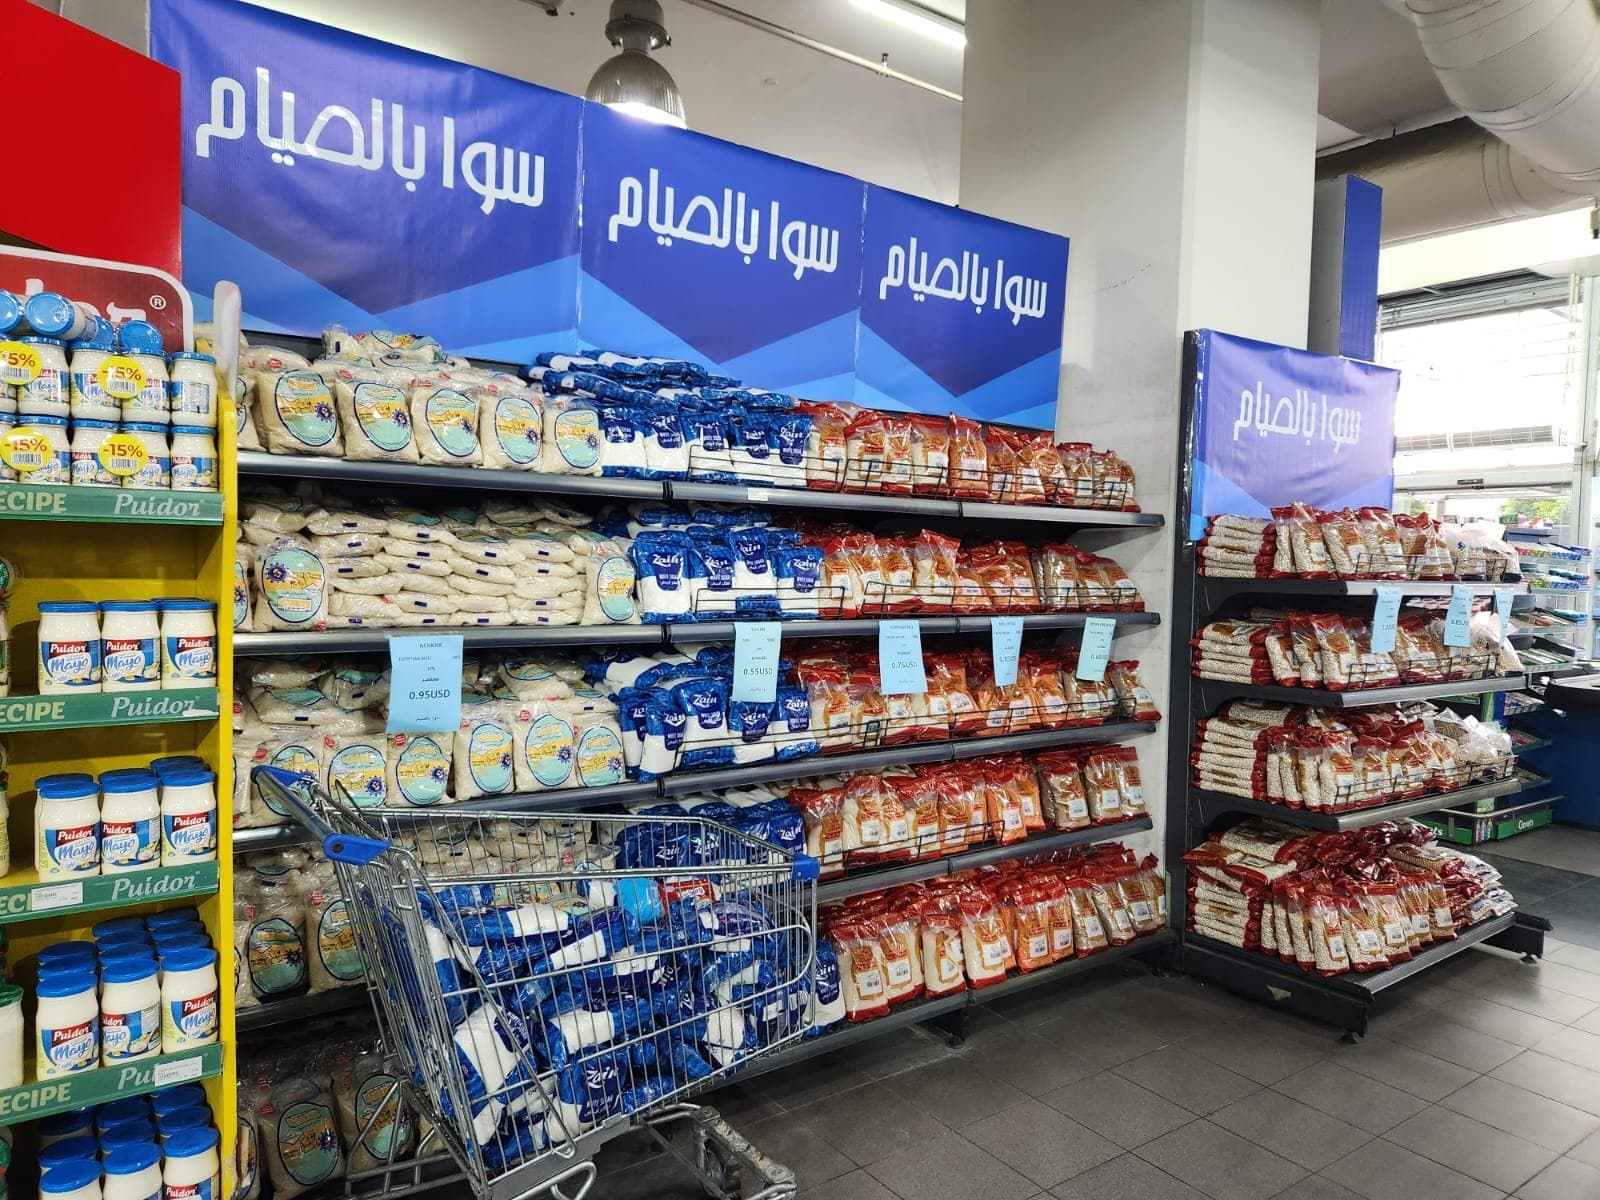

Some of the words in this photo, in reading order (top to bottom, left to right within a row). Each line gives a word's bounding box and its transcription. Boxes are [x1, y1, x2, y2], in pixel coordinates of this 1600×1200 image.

[195, 66, 427, 192] بالصيام
[442, 116, 545, 215] سوا
[608, 168, 760, 265] بالصيام
[768, 201, 840, 281] سوا
[879, 237, 990, 314] بالصيام
[994, 259, 1048, 326] سوا
[1232, 381, 1317, 445] بالصيام
[1320, 394, 1361, 454] سوا
[103, 443, 143, 458] -15%
[113, 493, 201, 516] Puidor
[50, 642, 87, 653] Puidor
[106, 641, 139, 651] Puidor
[178, 638, 210, 648] Puidor
[51, 657, 89, 674] Mayo
[106, 655, 141, 670] Mayo
[178, 652, 211, 666] Mayo
[408, 689, 451, 700] 0.95USD
[693, 694, 718, 709] Zain
[111, 696, 196, 718] Puidor
[103, 823, 133, 834] Puidor
[173, 815, 207, 827] Puidor
[57, 828, 93, 841] Puidor
[173, 828, 209, 845] Mayo
[58, 842, 95, 859] Mayo
[103, 837, 135, 855] Mayo
[112, 874, 195, 900] Puidor
[53, 1026, 91, 1042] Puidor
[55, 1038, 91, 1060] Mayo
